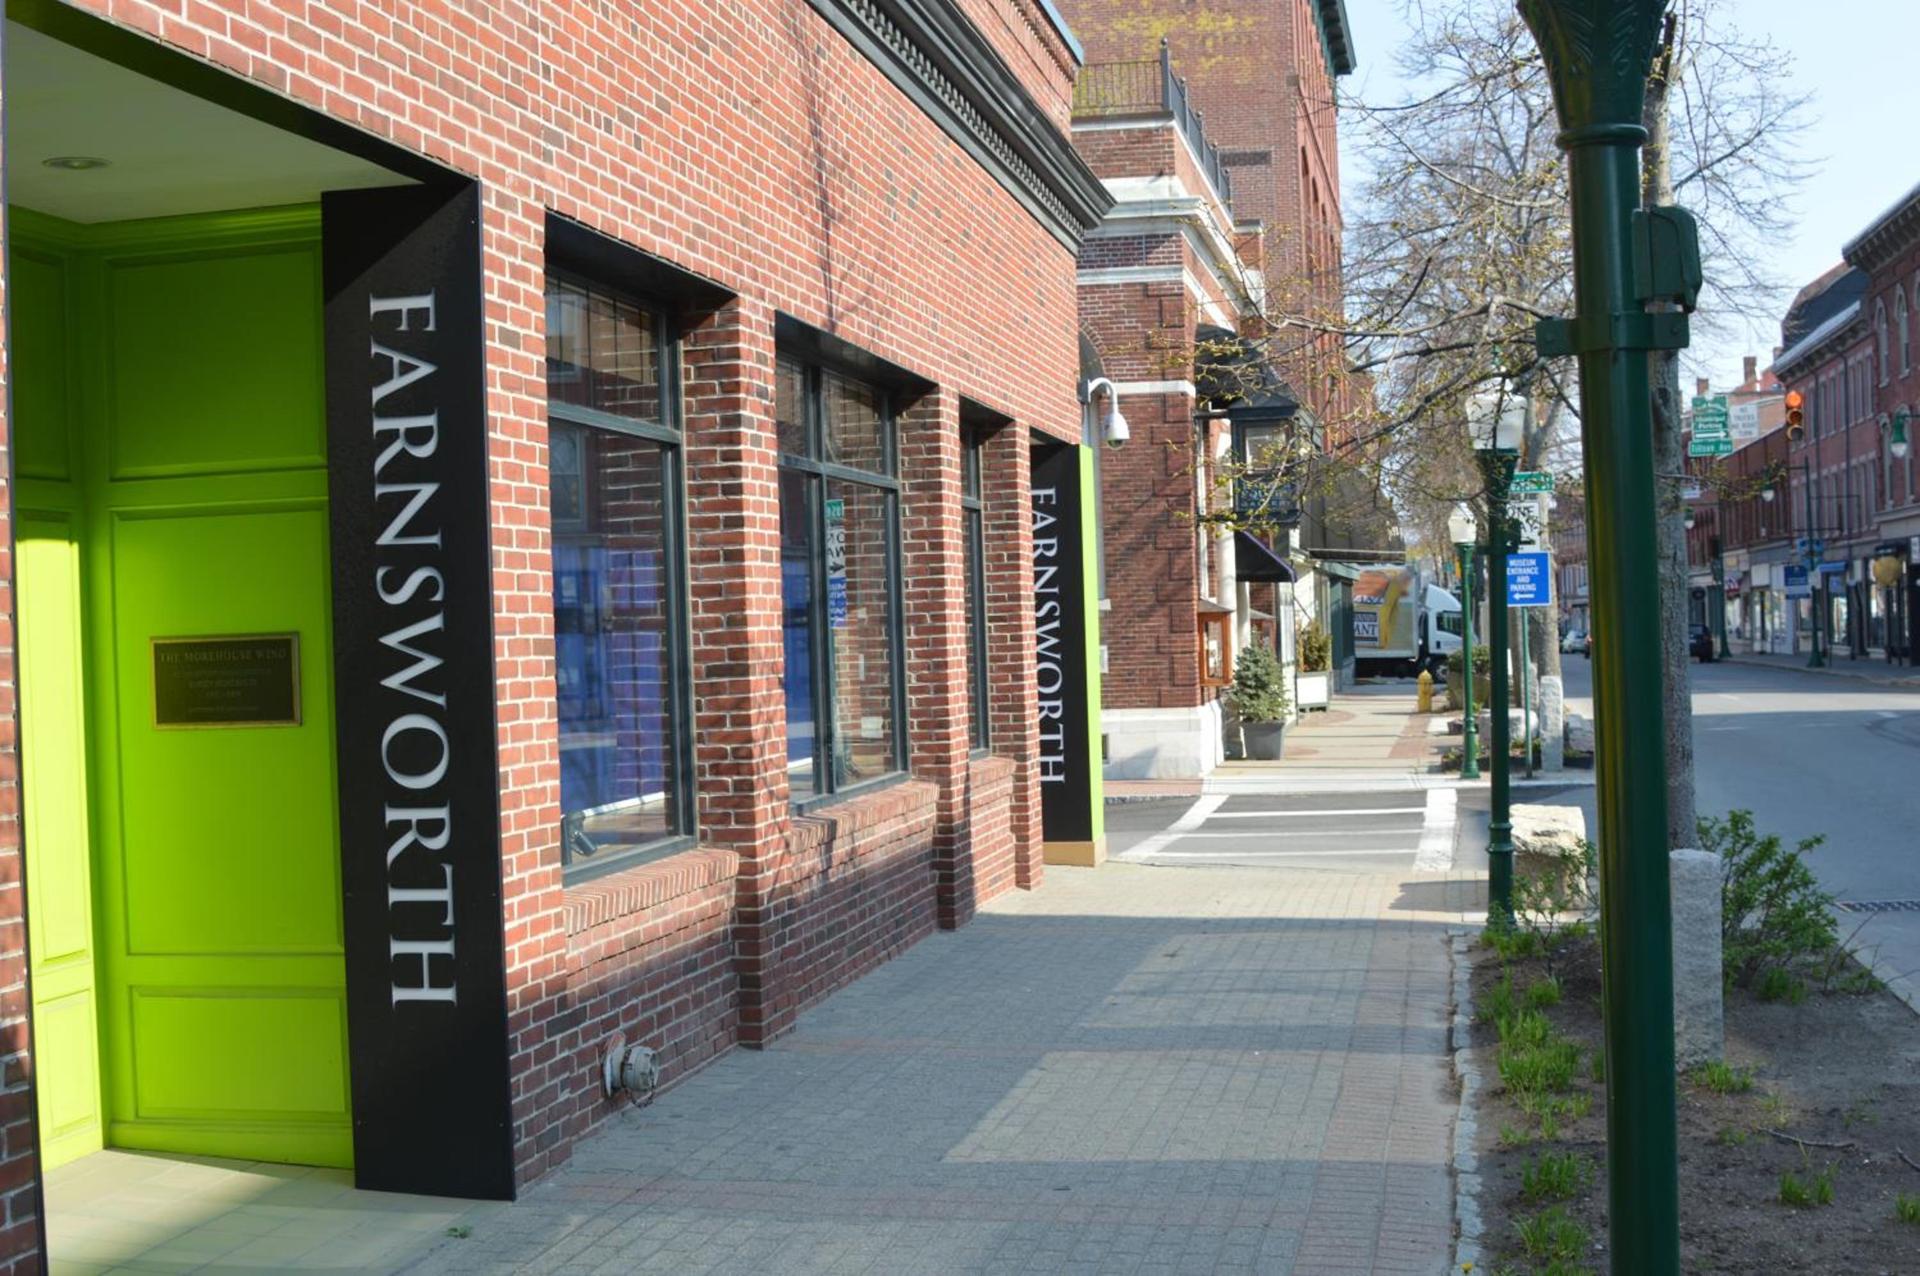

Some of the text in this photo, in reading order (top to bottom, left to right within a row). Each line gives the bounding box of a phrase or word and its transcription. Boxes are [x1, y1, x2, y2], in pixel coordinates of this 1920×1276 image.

[1698, 423, 1724, 432] Parking
[1509, 559, 1537, 567] MUSEUM
[1506, 566, 1539, 576] ENTRANCE
[1516, 575, 1531, 584] AND
[1510, 583, 1537, 592] PARKING
[1354, 623, 1377, 636] ANT
[1030, 487, 1065, 783] FARNSWORTH
[368, 288, 458, 1008] FARNSWORTH
